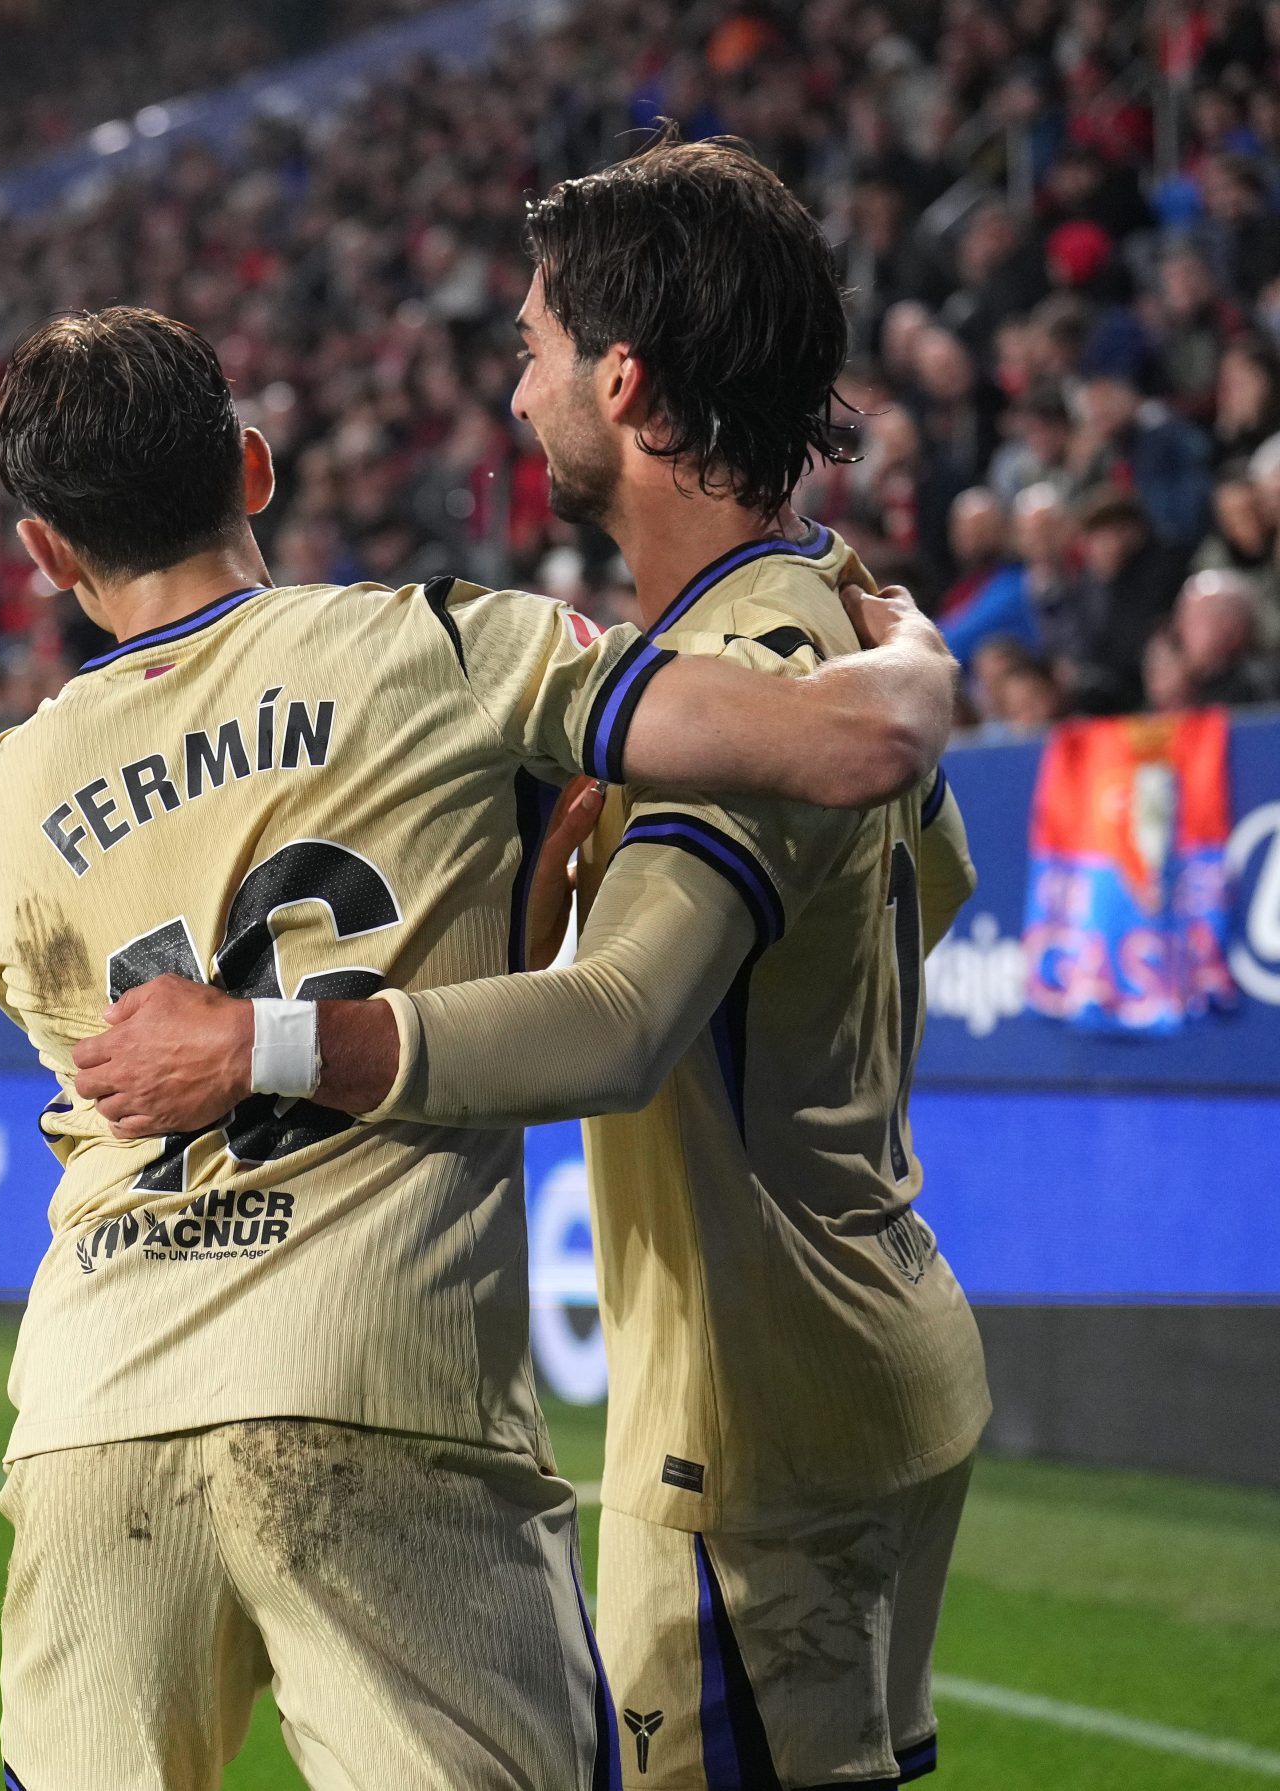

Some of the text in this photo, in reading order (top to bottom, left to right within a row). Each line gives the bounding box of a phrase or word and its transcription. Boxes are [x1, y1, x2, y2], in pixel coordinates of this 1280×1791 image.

[40, 684, 336, 879] FERMÍN
[106, 837, 404, 1194] 16
[178, 1188, 296, 1219] NHCR
[142, 1218, 290, 1249] ACNUR
[143, 1249, 166, 1261] The
[169, 1250, 188, 1261] UN
[190, 1248, 238, 1261] Refugee
